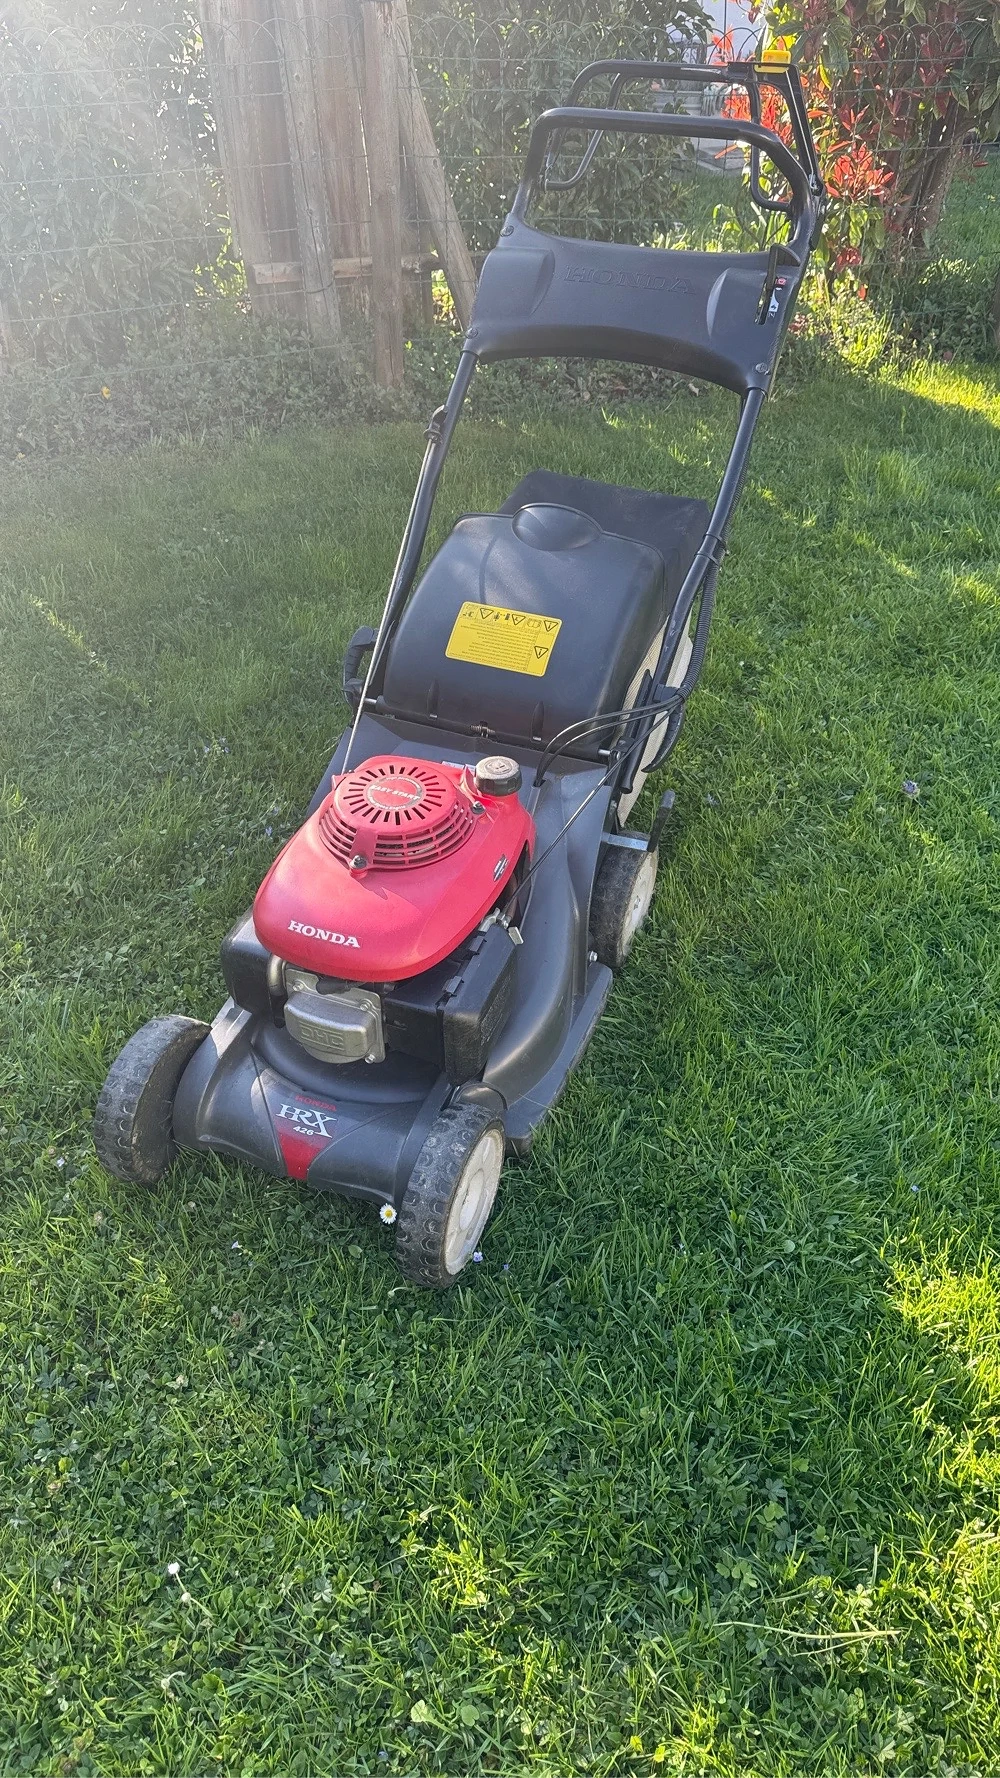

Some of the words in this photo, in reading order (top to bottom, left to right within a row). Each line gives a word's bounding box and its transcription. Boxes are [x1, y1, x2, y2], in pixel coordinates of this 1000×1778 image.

[564, 264, 696, 295] HONDA
[370, 784, 393, 793] EASY
[392, 790, 421, 800] START
[287, 919, 361, 948] HONDA
[295, 1094, 337, 1111] HONDA
[276, 1103, 337, 1138] HRX
[293, 1126, 314, 1136] 426
